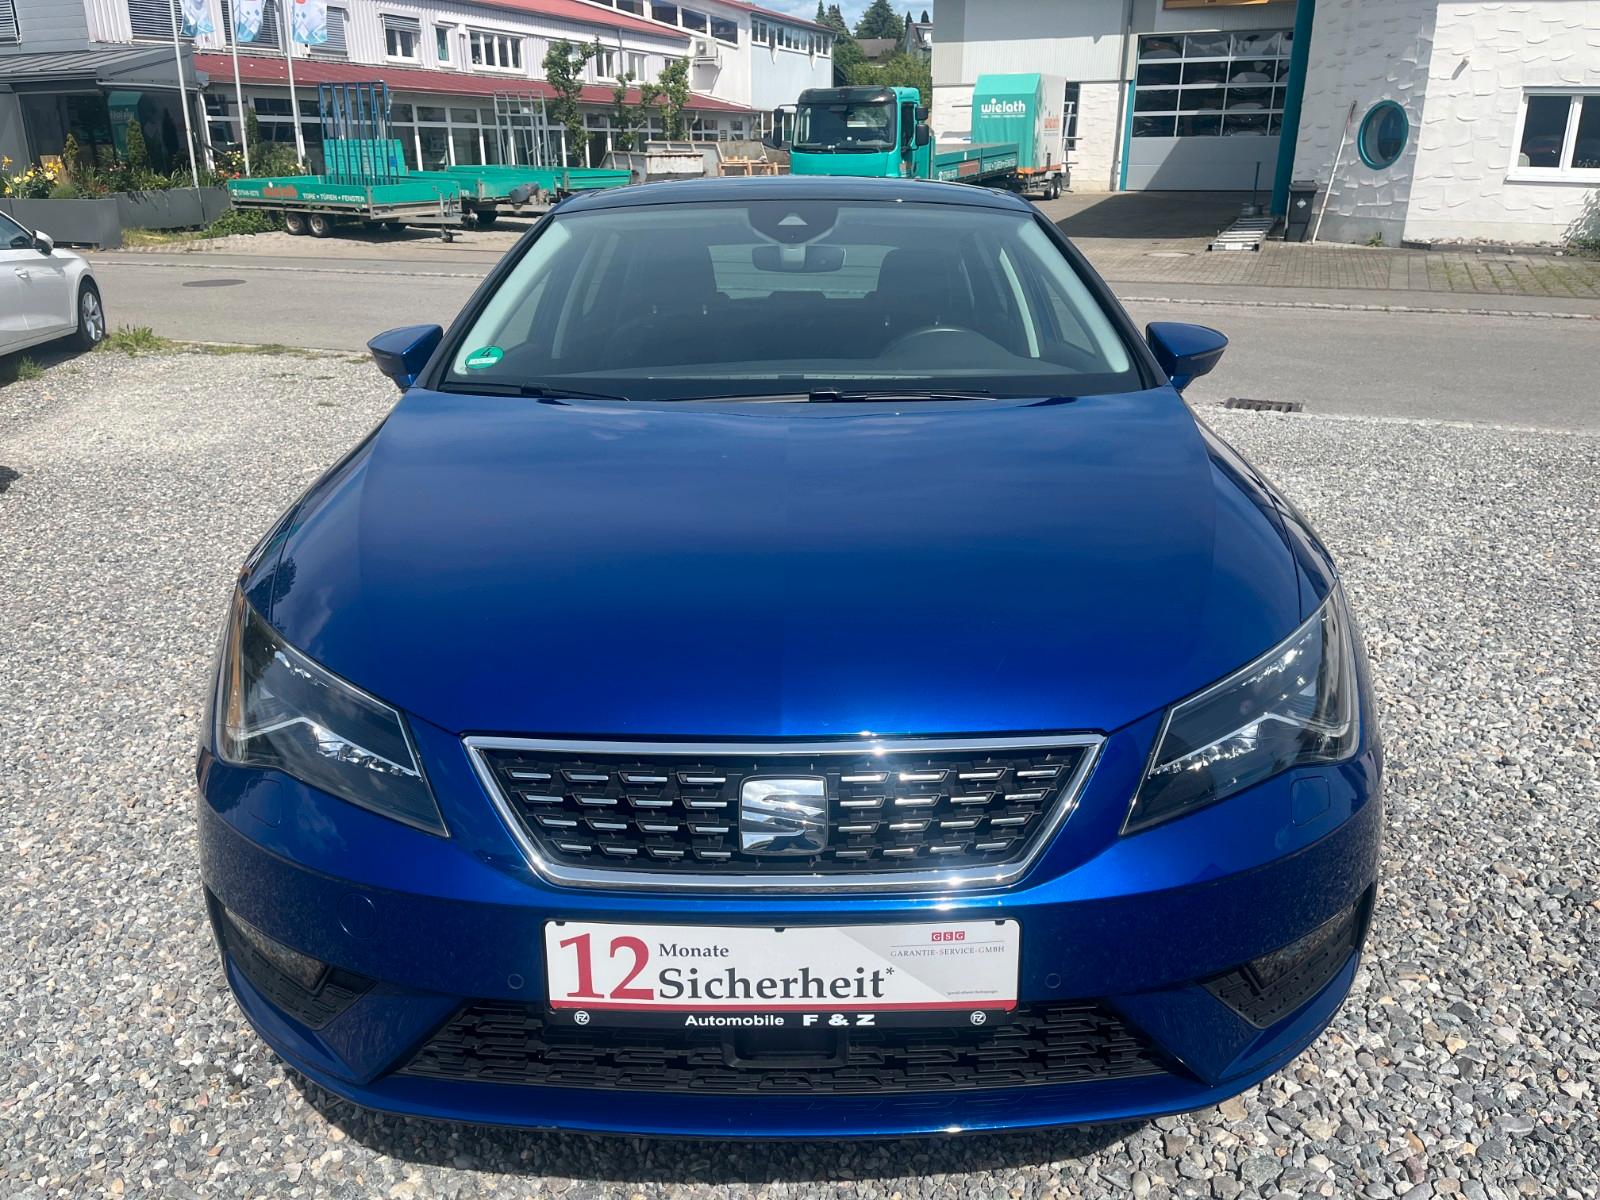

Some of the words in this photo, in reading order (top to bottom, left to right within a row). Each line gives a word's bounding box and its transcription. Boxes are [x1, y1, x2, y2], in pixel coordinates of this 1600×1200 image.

[981, 98, 1026, 113] wielath
[481, 347, 492, 357] 4
[932, 931, 966, 942] GSG
[659, 943, 730, 958] Monate
[559, 933, 655, 1000] 12
[684, 1014, 785, 1027] Automobile
[802, 1014, 819, 1027] F
[856, 1013, 876, 1026] Z
